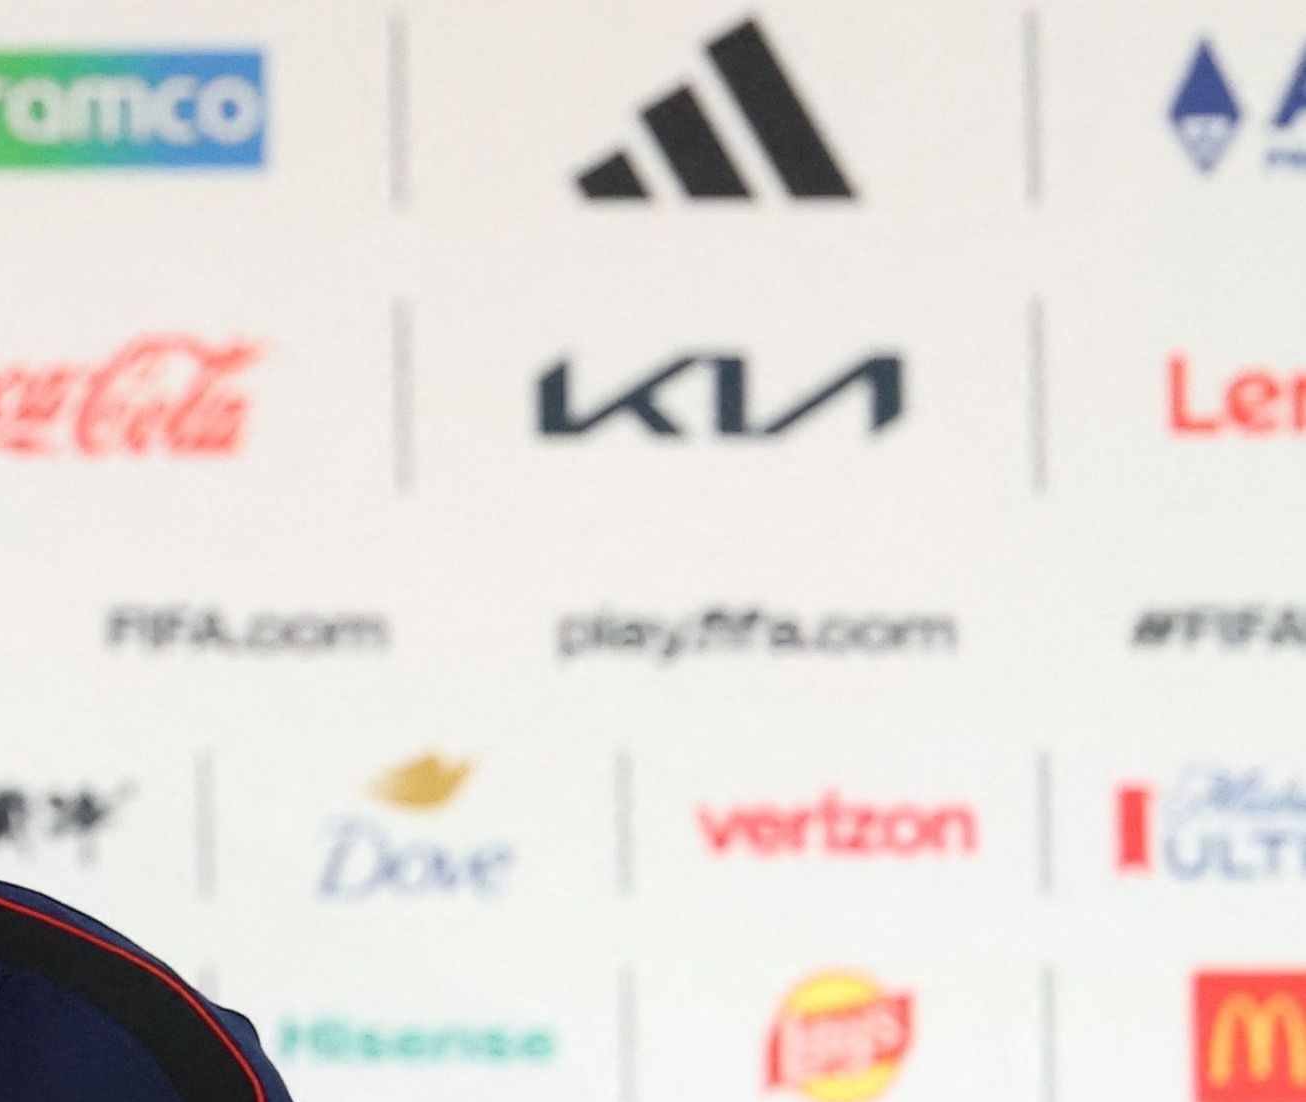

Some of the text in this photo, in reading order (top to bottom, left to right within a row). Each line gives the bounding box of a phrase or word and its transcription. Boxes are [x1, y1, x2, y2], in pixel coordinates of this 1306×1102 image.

[103, 605, 390, 655] FIFA.com
[695, 790, 980, 858] verizon
[1162, 826, 1306, 882] ULT
[316, 815, 516, 899] Dove
